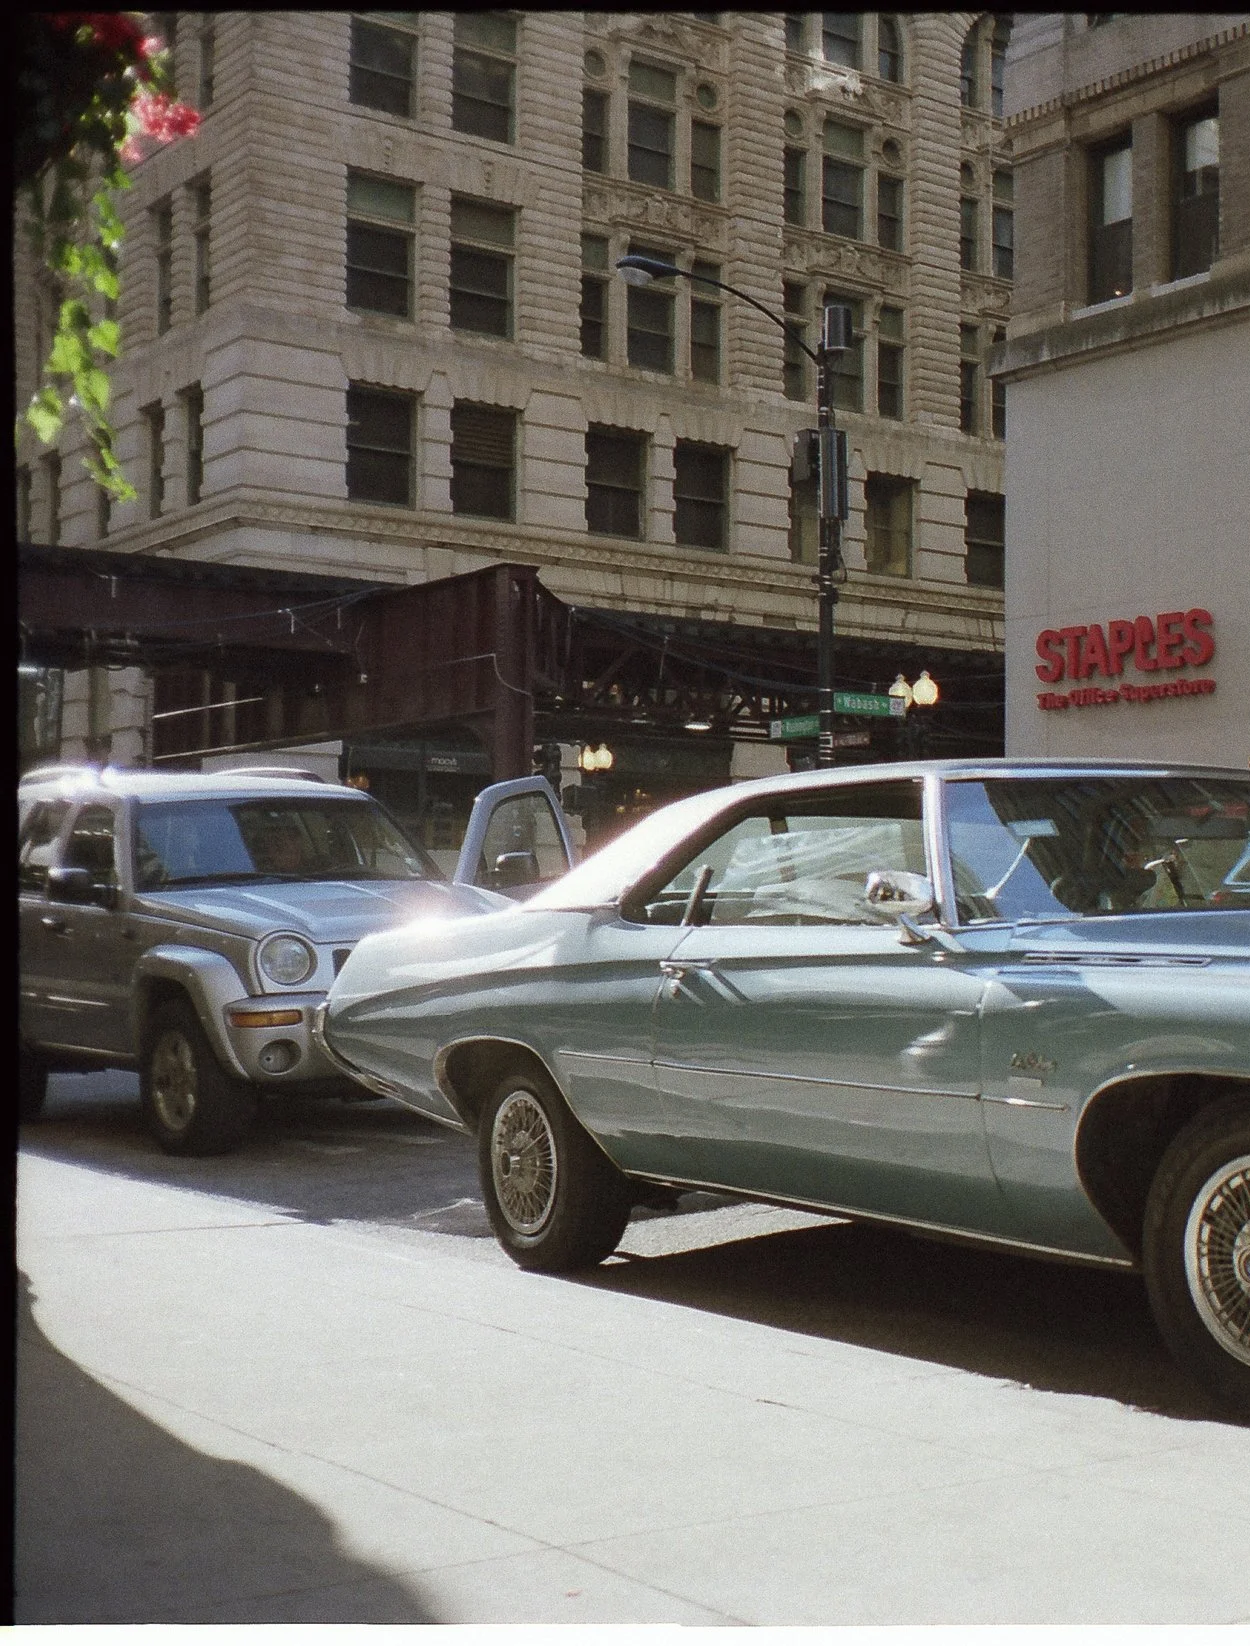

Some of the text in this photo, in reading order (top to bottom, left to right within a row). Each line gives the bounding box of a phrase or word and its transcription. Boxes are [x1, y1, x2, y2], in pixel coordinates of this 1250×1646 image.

[1035, 608, 1216, 683] STAPLES
[1036, 679, 1216, 710] The Office Superstore
